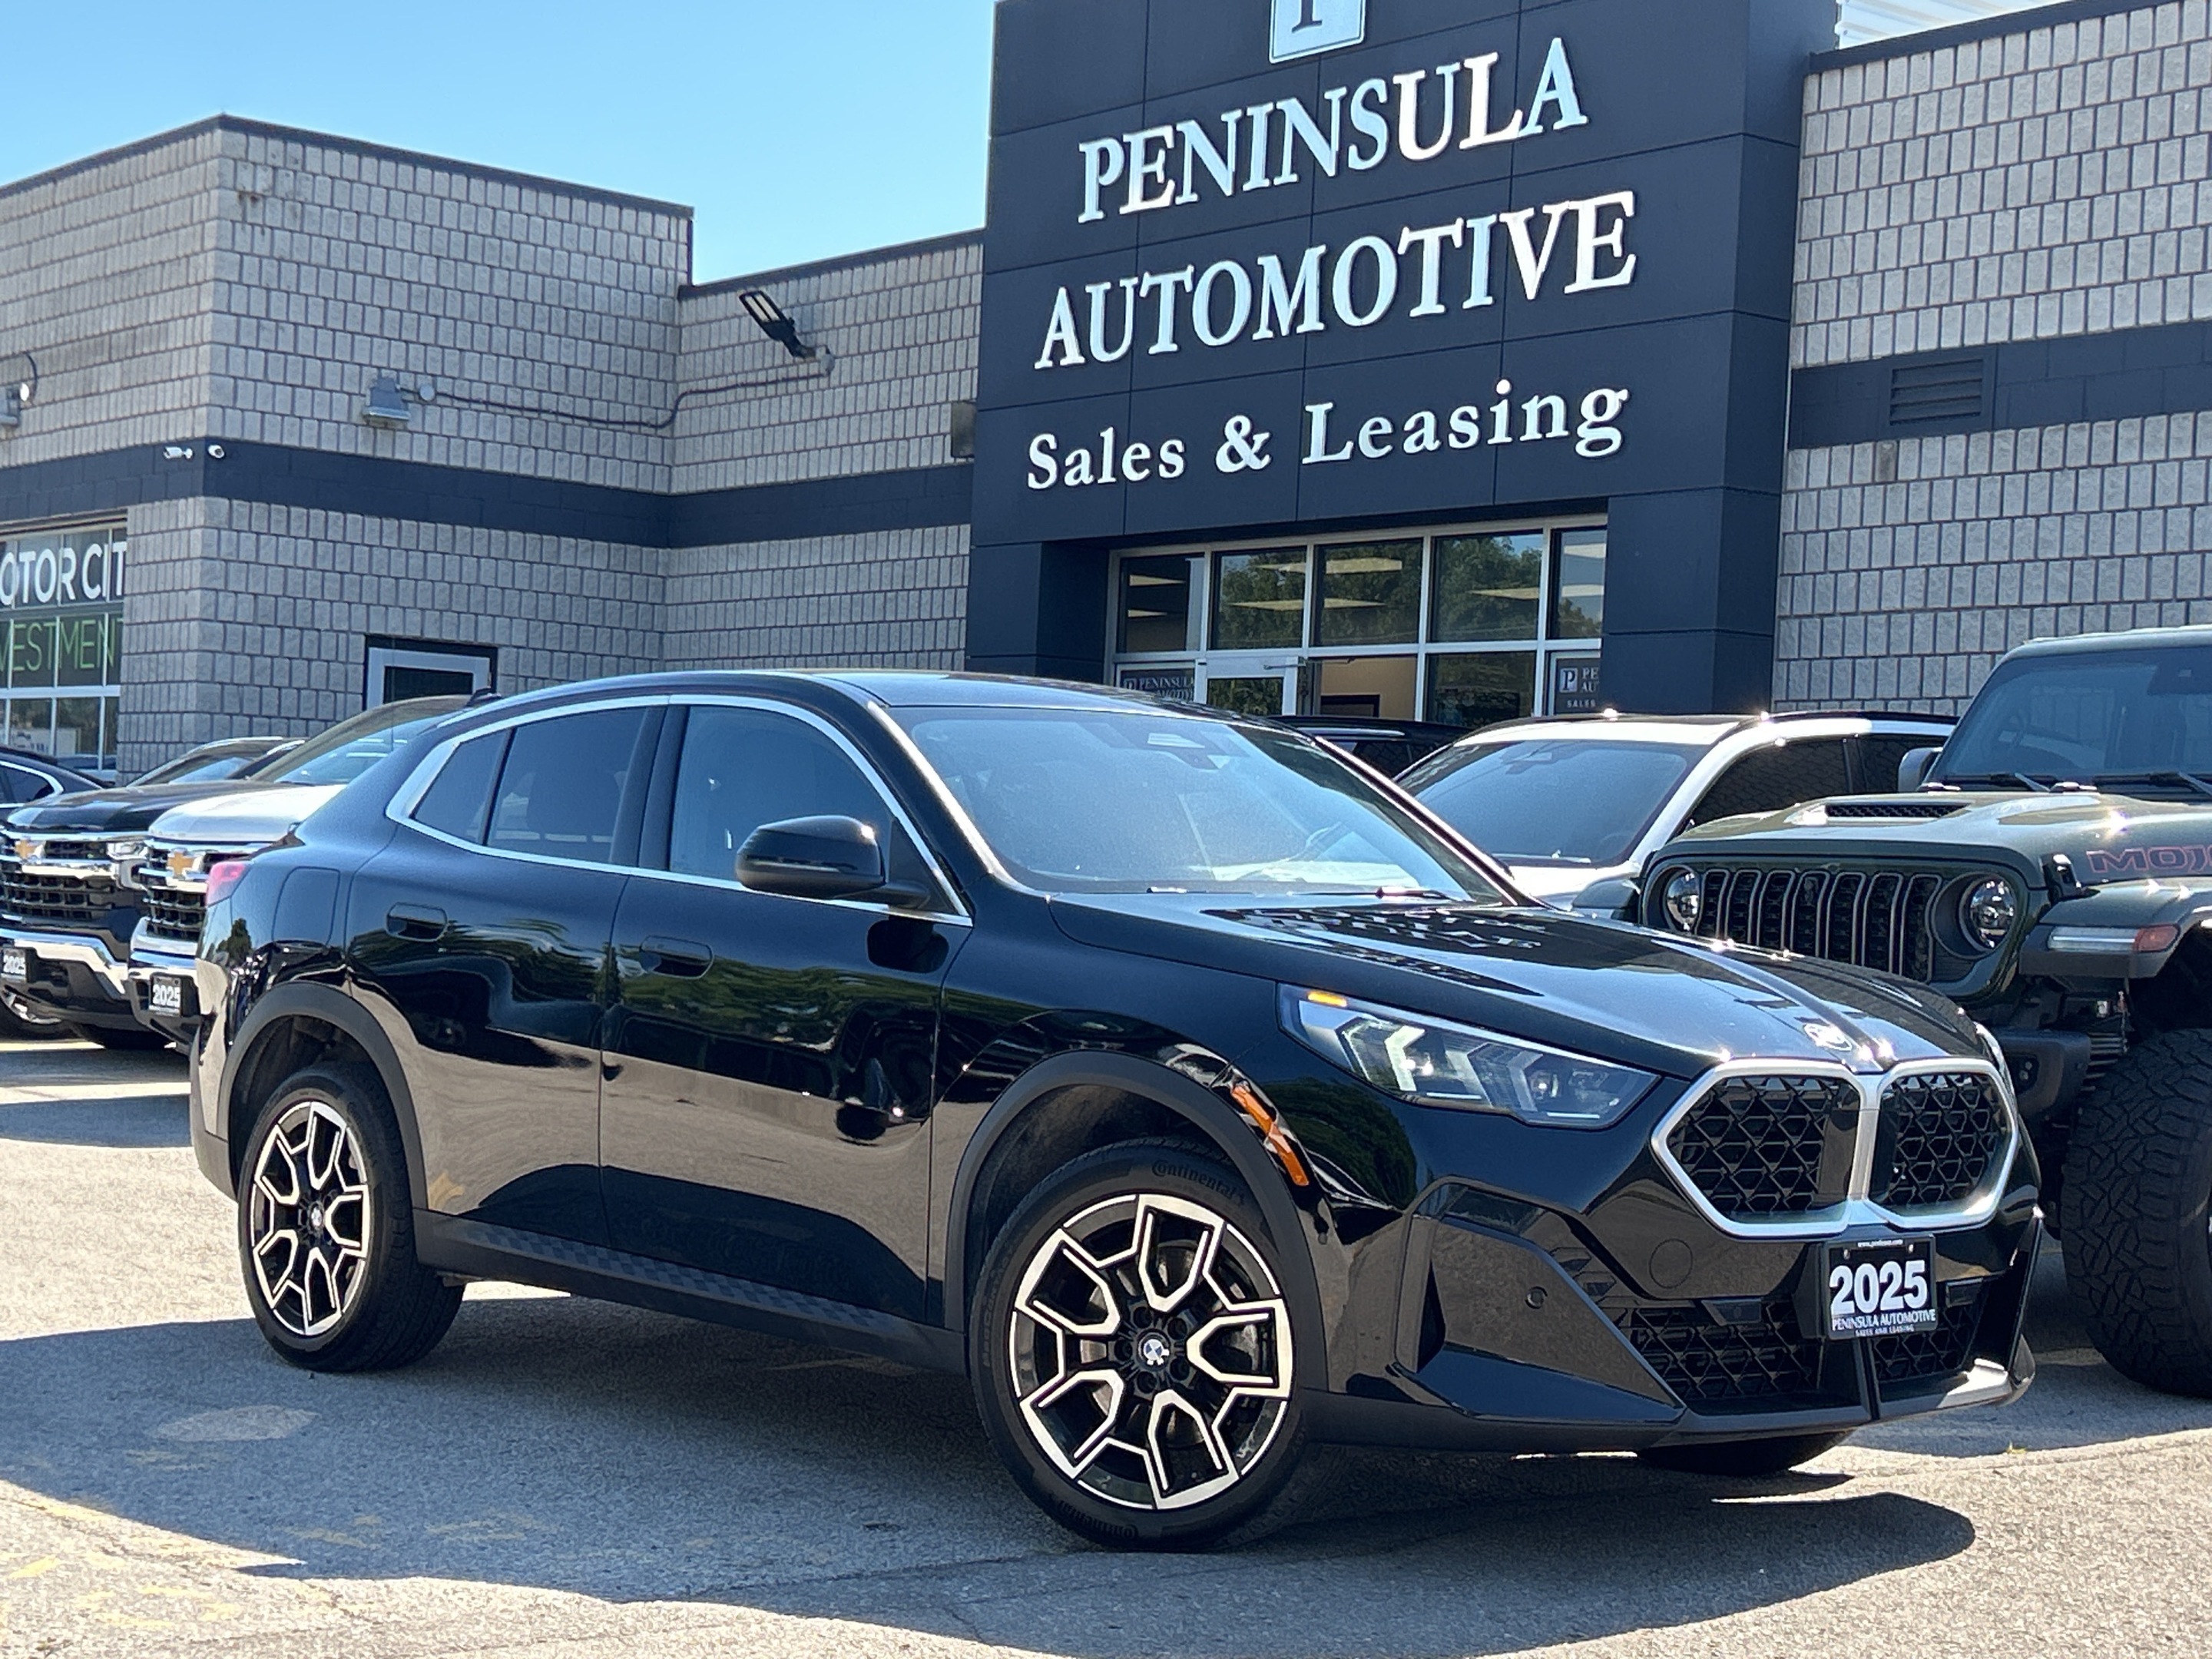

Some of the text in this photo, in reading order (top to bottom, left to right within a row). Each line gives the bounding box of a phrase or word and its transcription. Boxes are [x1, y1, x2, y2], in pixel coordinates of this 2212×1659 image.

[1078, 38, 1588, 223] PENINSULA
[1034, 190, 1637, 370] AUTOMOTIVE
[1027, 379, 1630, 490] Sales & Leasing
[2086, 845, 2212, 874] MOJ
[153, 984, 180, 1008] 2025
[1830, 1260, 1928, 1314] 2025
[1832, 1309, 1936, 1331] PENINSULA AUTOMOTIVE
